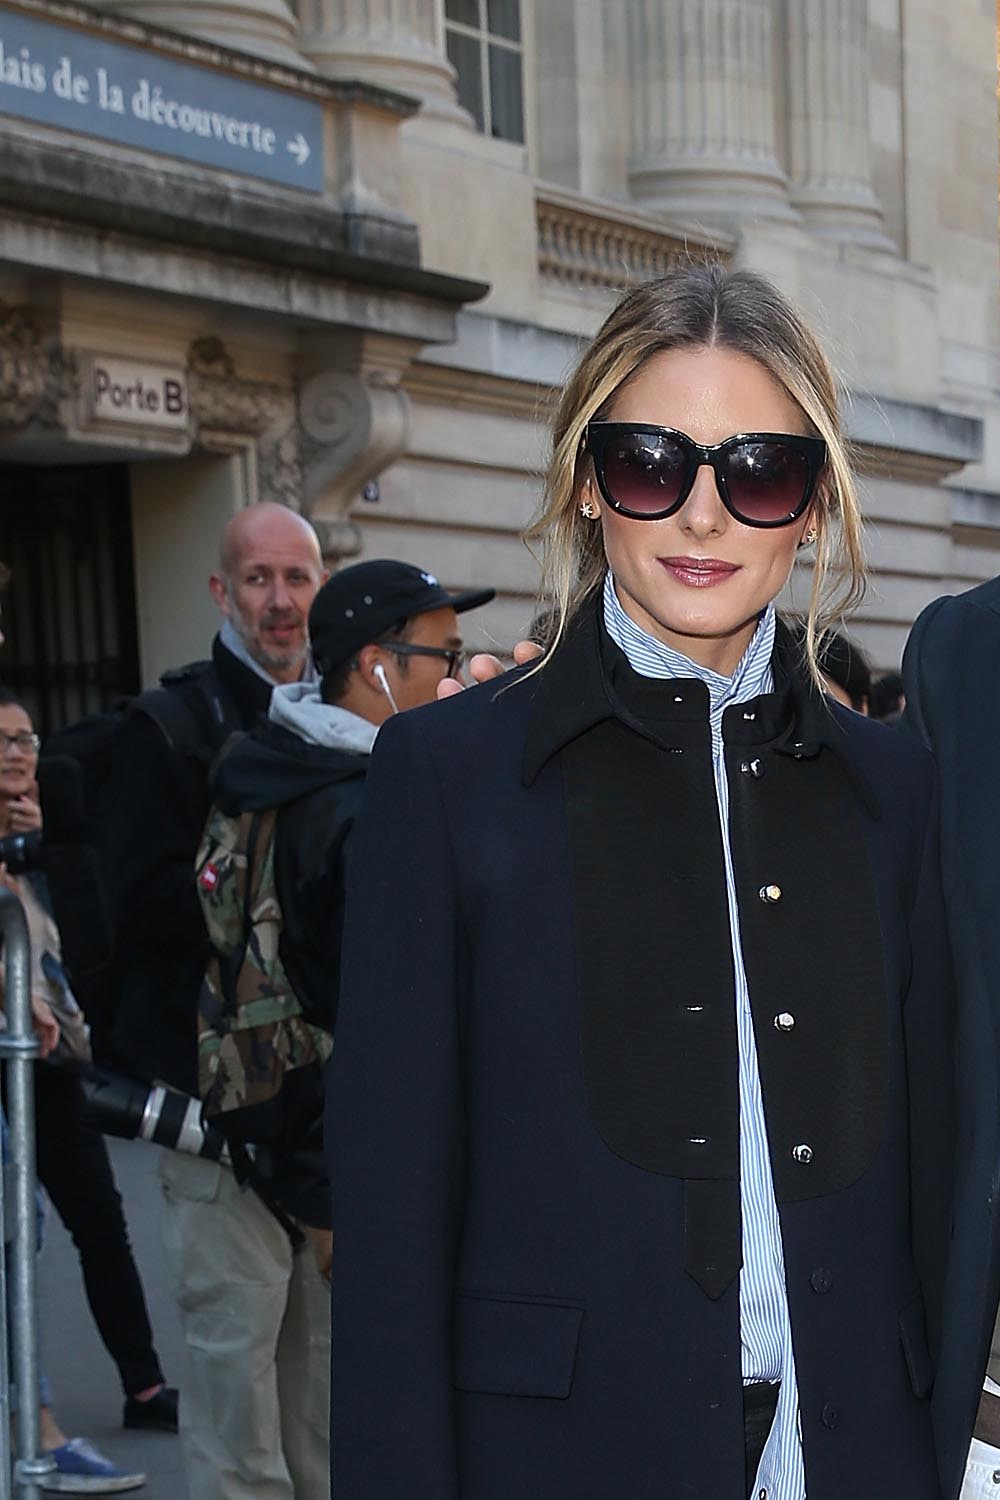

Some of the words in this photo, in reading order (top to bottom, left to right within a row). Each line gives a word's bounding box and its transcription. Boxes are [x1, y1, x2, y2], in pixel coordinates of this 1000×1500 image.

[52, 57, 90, 104] de
[97, 67, 124, 114] la
[131, 78, 276, 155] découverte
[95, 368, 159, 413] Porte
[164, 379, 183, 414] B
